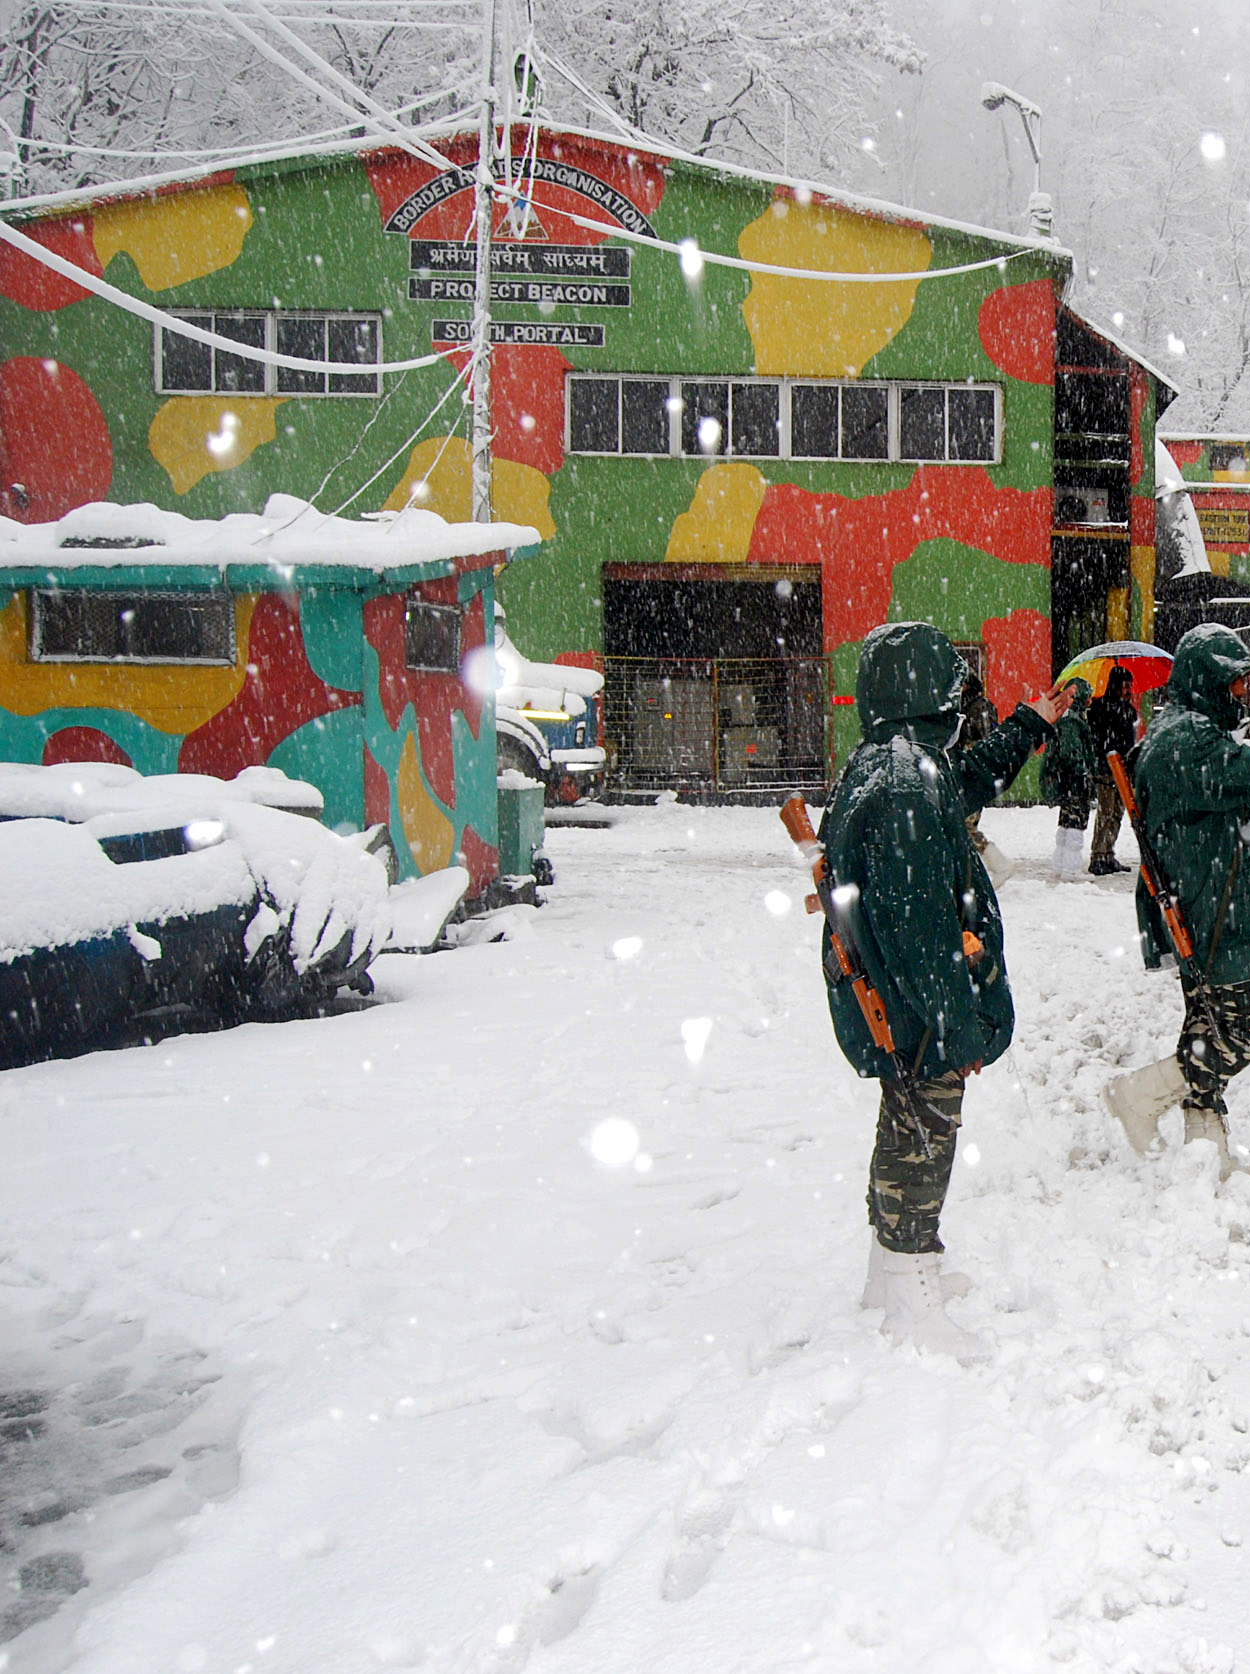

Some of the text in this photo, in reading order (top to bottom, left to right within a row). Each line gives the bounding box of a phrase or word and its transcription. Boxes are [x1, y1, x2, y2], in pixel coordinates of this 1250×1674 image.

[393, 175, 457, 230] BORDER
[530, 160, 646, 235] ORGANISATION
[431, 281, 607, 302] PROECT BEACON
[445, 323, 587, 343] SOTH PORTAL
